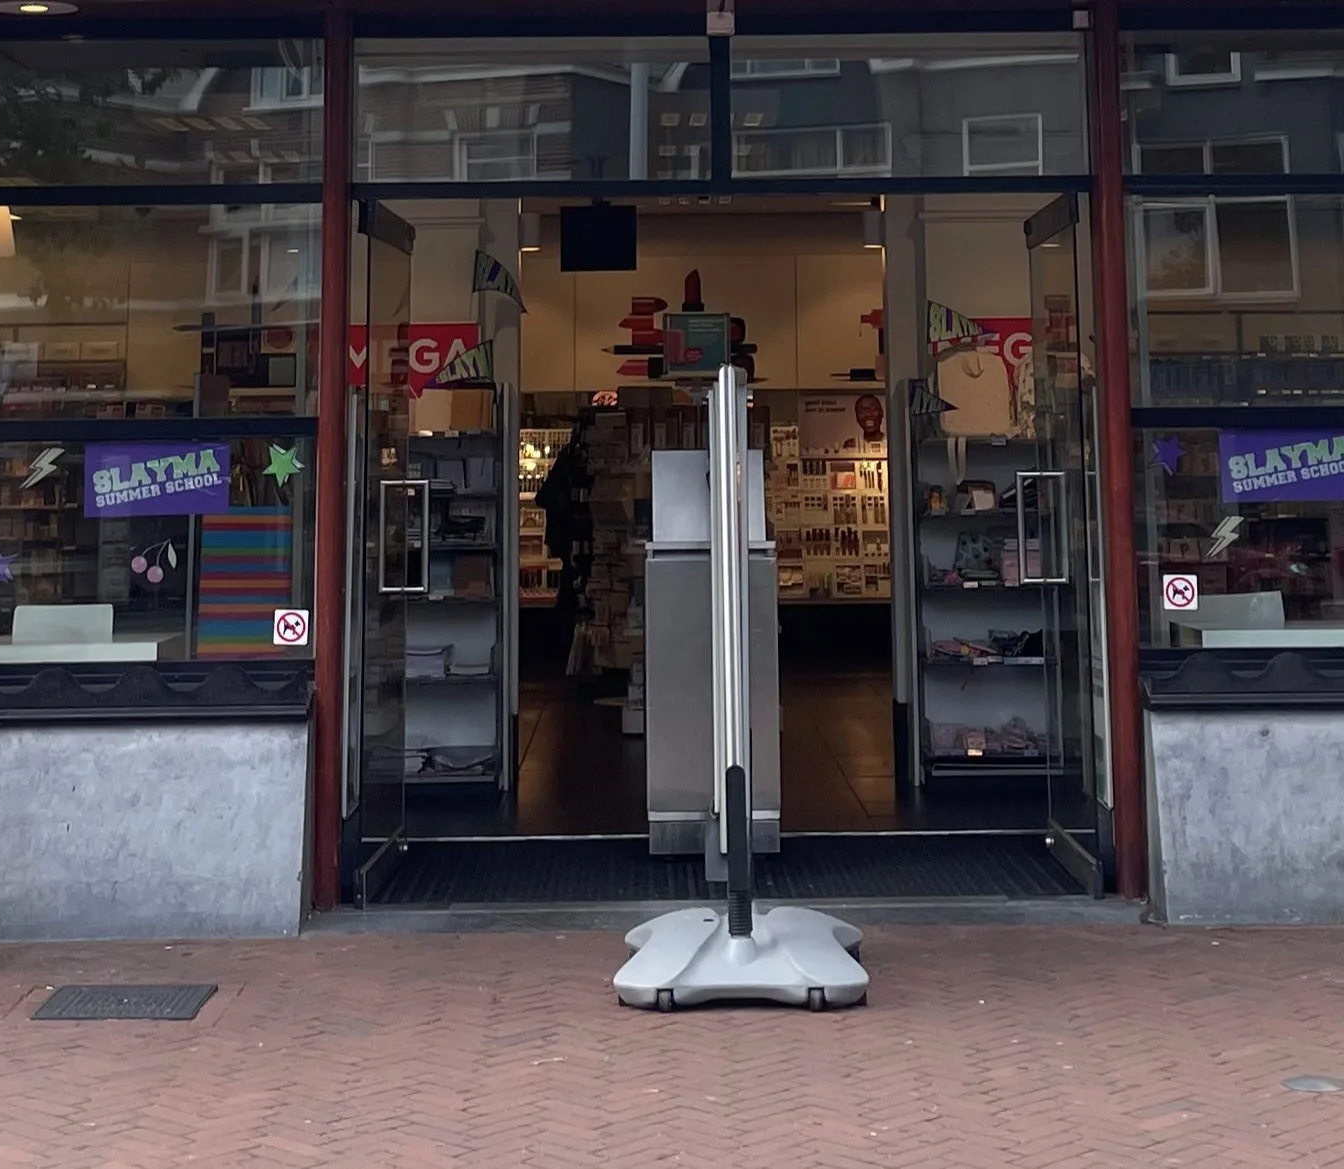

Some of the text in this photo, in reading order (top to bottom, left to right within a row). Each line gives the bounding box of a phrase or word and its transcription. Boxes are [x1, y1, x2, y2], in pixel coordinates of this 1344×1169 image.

[93, 449, 221, 494] SLAYMA
[1232, 470, 1298, 494] SUMMER
[95, 472, 223, 508] SUMMER SCHOOL
